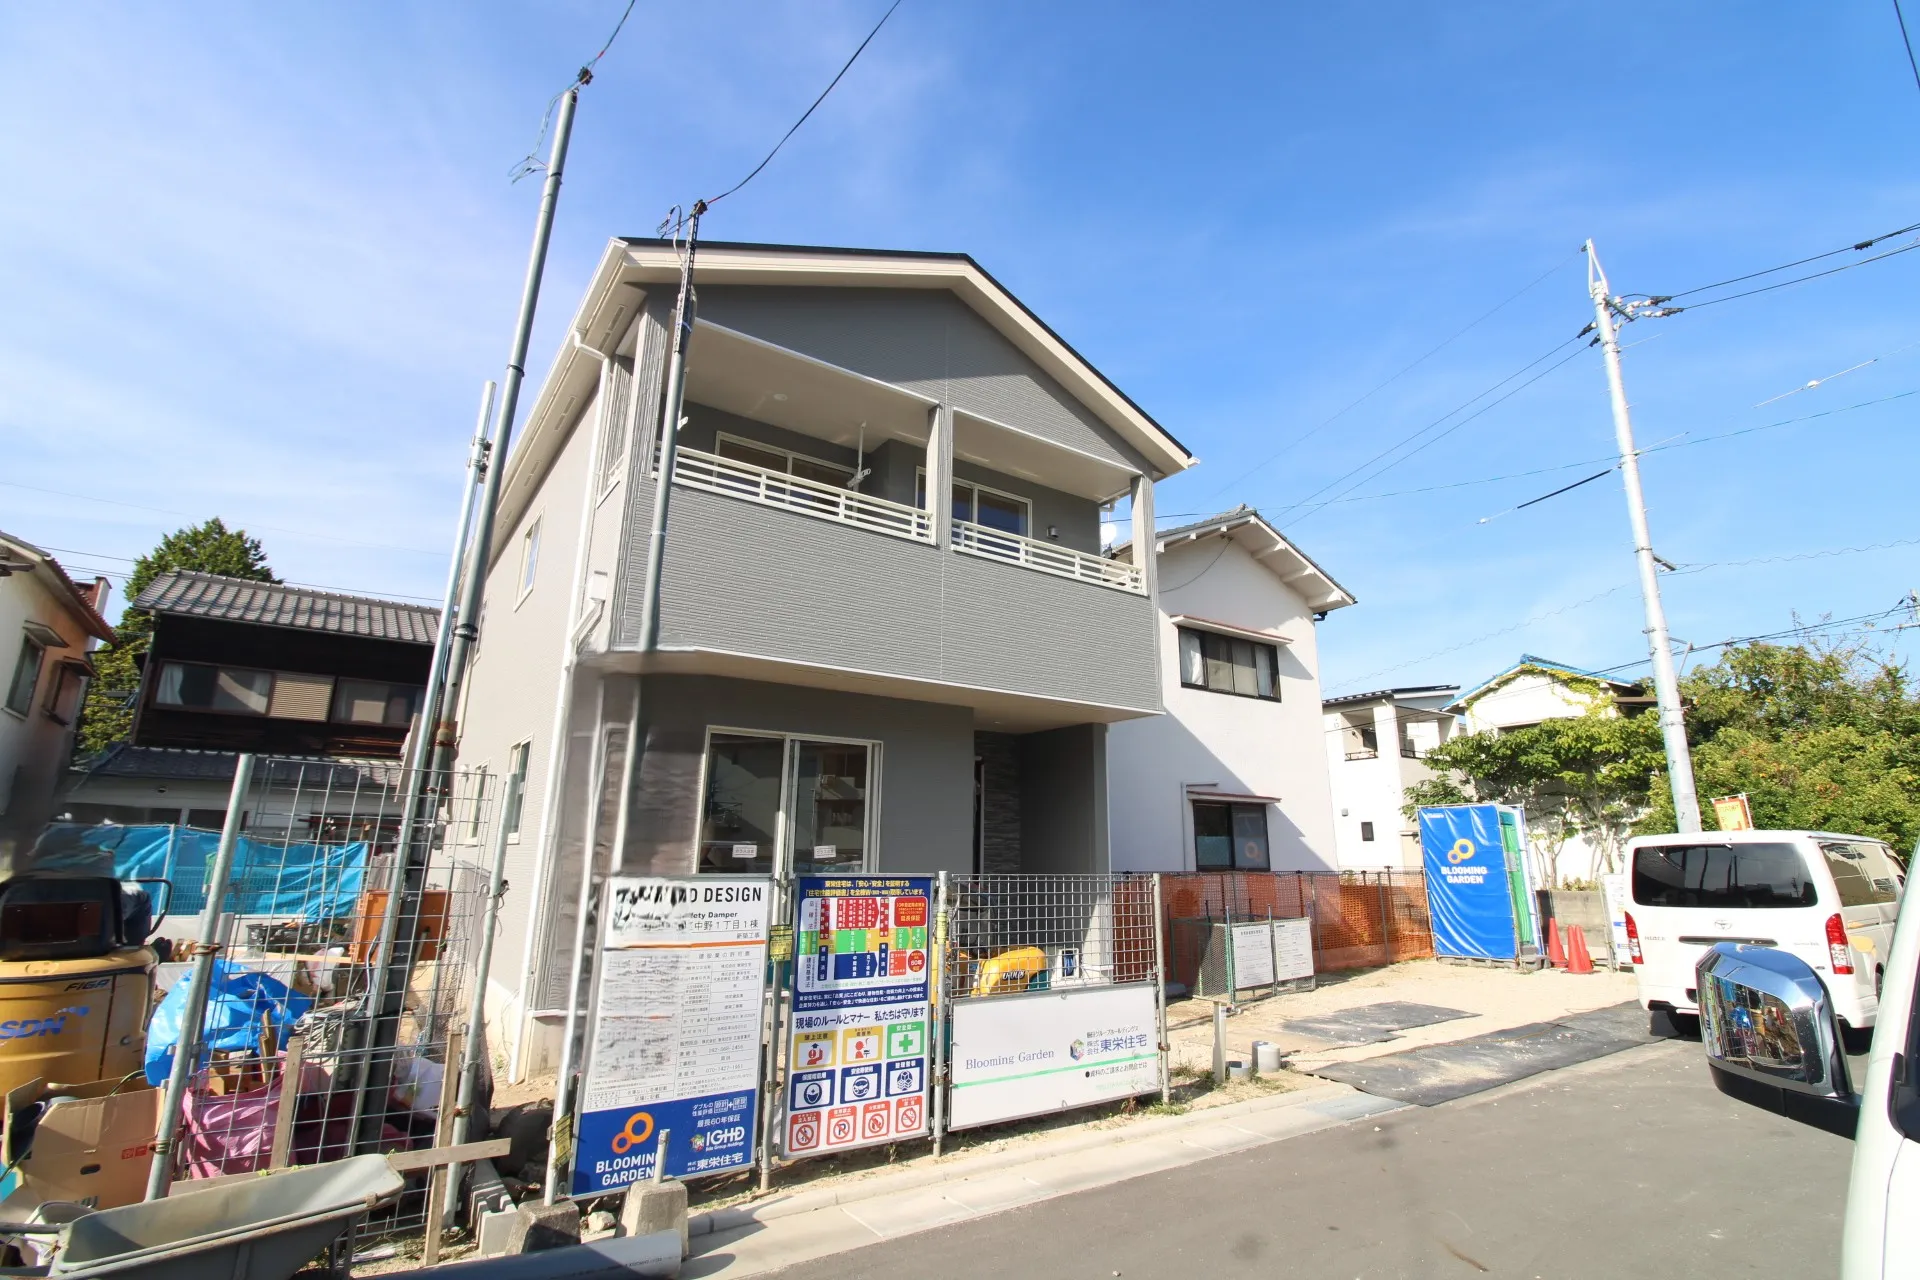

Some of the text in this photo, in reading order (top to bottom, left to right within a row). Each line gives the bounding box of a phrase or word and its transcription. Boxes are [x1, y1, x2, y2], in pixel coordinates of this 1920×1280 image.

[1441, 866, 1488, 874] BLOOMING
[1447, 876, 1484, 884] GARDEN
[704, 887, 761, 902] DESIGN
[796, 1006, 926, 1029] 現場のルールとマナー 私たちは守ります
[1100, 1034, 1147, 1052] 東栄住宅
[966, 1049, 1054, 1070] Blooming Garden
[697, 1114, 740, 1128] 最長60年保証
[706, 1126, 744, 1147] IGHD
[596, 1152, 658, 1173] BLOOMIN
[696, 1152, 744, 1170] 東栄住宅
[602, 1170, 655, 1186] GARDEN
